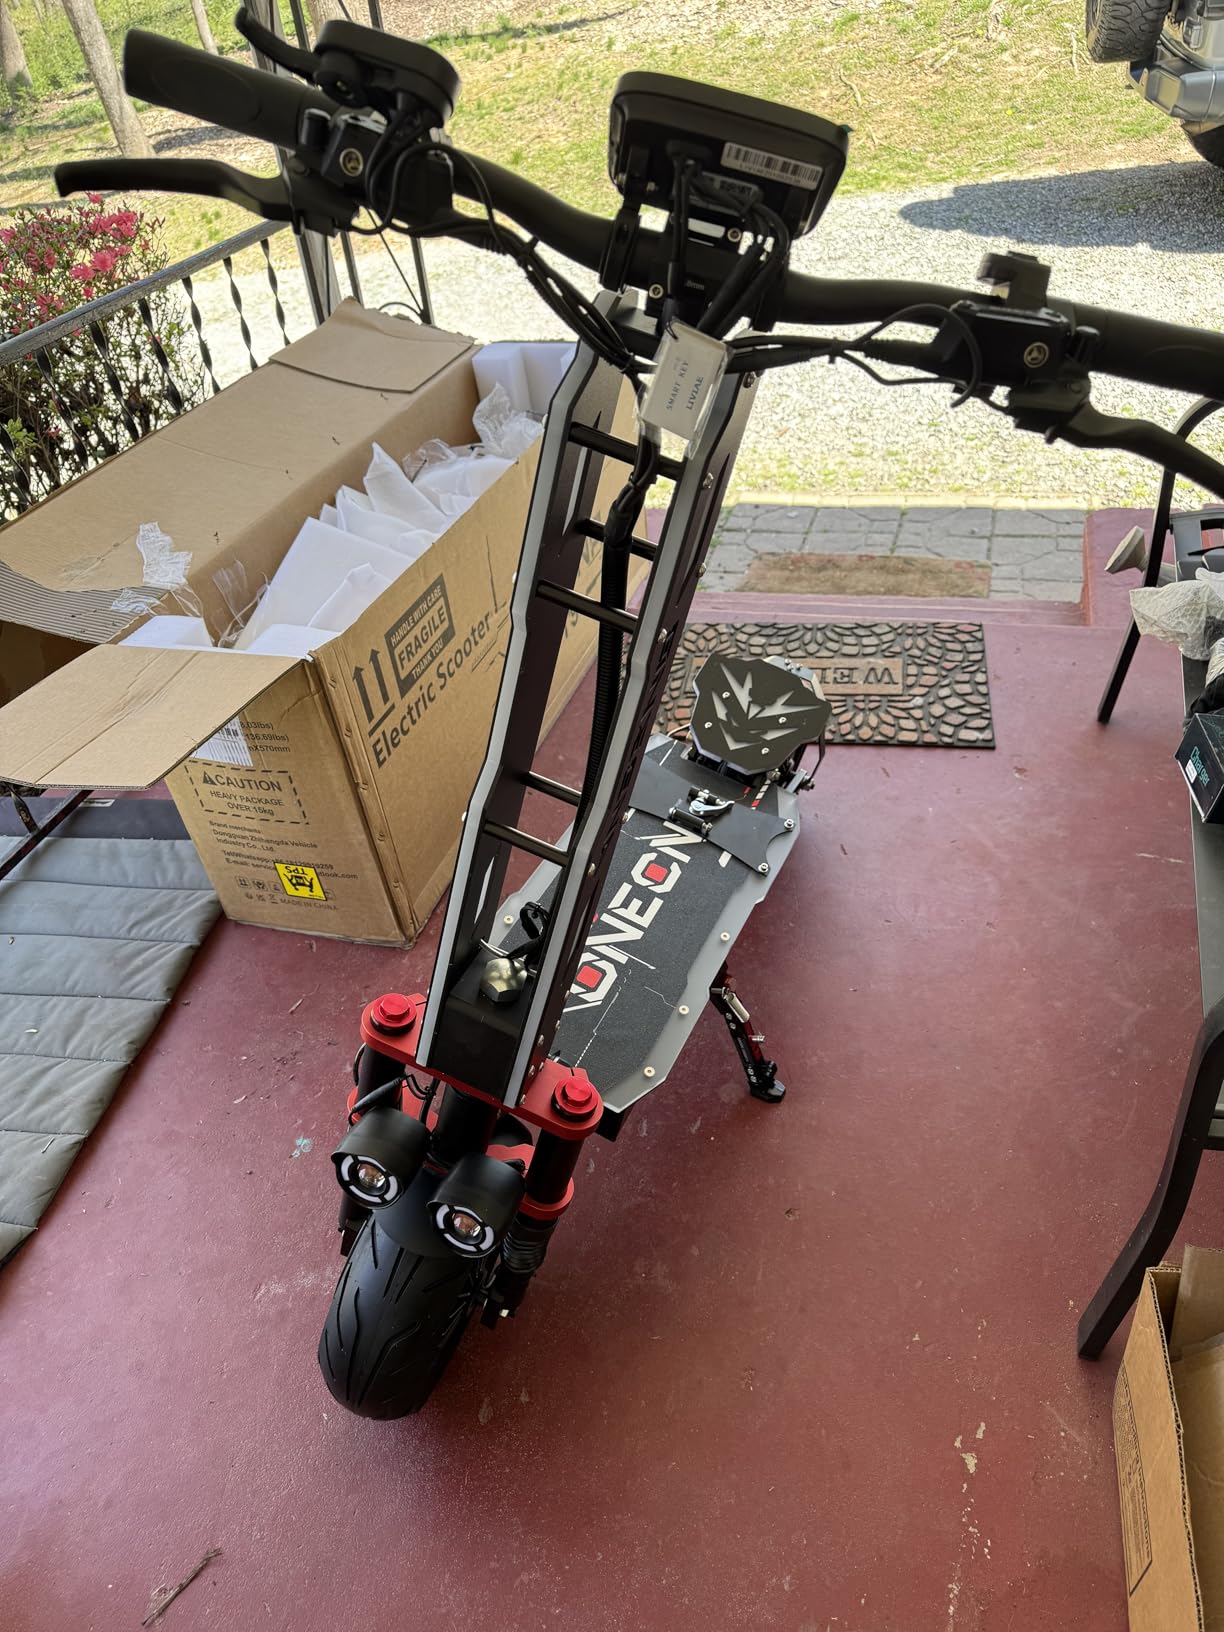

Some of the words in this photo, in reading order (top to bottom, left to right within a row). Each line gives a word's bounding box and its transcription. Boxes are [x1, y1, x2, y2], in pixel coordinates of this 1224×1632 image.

[666, 382, 681, 411] SMART
[678, 361, 689, 378] KEY
[390, 617, 415, 647] HANDLE
[413, 603, 430, 623] WITH
[427, 585, 443, 610] CARE
[398, 605, 447, 671] FRAGILE
[411, 650, 434, 680] THANK
[431, 637, 444, 658] YOU
[371, 682, 437, 769] Electric
[436, 611, 490, 691] Scooter
[215, 774, 283, 792] CAUTION
[1190, 746, 1210, 787] Charger
[210, 790, 238, 800] HEAVY
[239, 795, 286, 806] PACKAGE
[227, 802, 251, 813] OVER
[253, 806, 275, 817] 15kg
[289, 840, 318, 849] Vehicle
